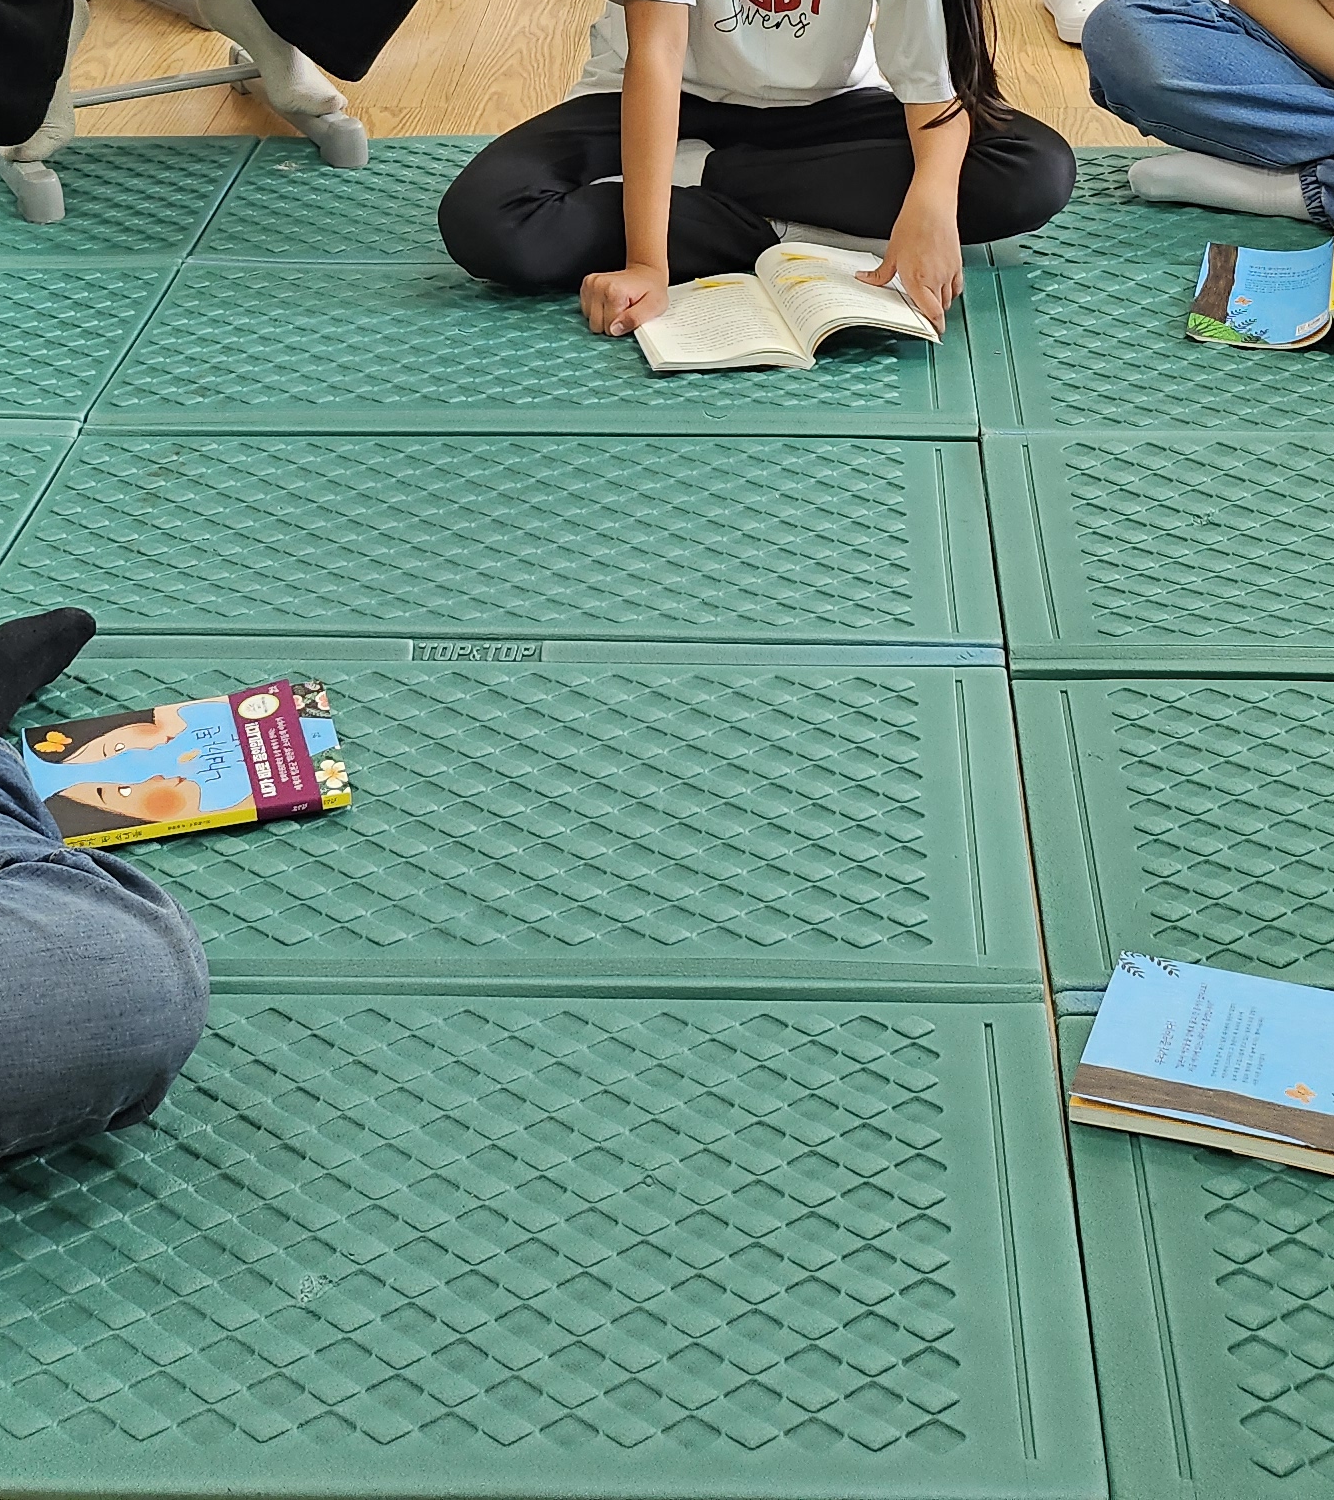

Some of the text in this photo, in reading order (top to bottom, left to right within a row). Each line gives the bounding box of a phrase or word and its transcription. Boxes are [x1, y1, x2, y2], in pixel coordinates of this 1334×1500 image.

[418, 642, 536, 662] TOP&TOP
[192, 726, 234, 783] 나비가 된
